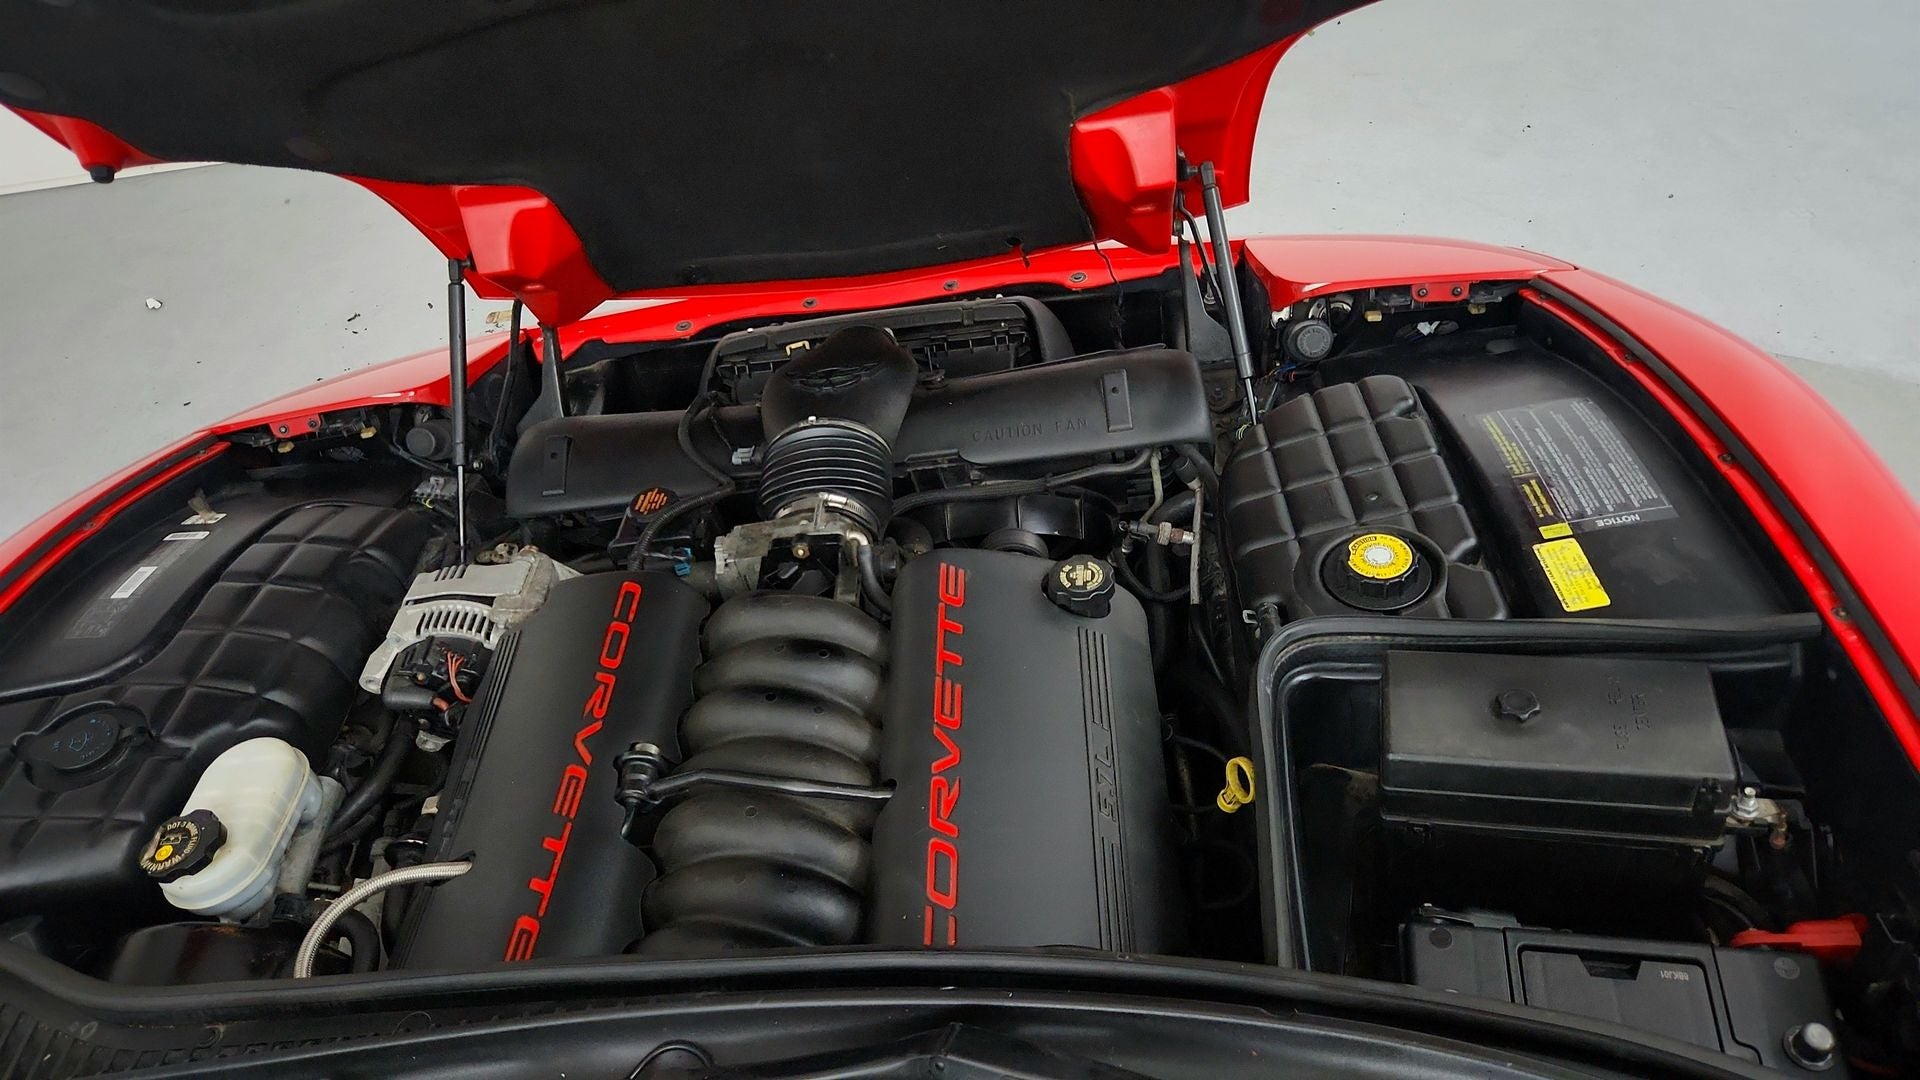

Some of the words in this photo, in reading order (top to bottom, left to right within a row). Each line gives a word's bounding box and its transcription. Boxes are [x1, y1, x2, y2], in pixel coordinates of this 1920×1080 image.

[972, 422, 1043, 441] CAUTION
[1055, 416, 1088, 433] FAN
[1596, 513, 1641, 528] NOTICE
[505, 581, 642, 961] CORVETTE
[1095, 745, 1117, 822] 5.7L
[167, 821, 182, 831] DOT
